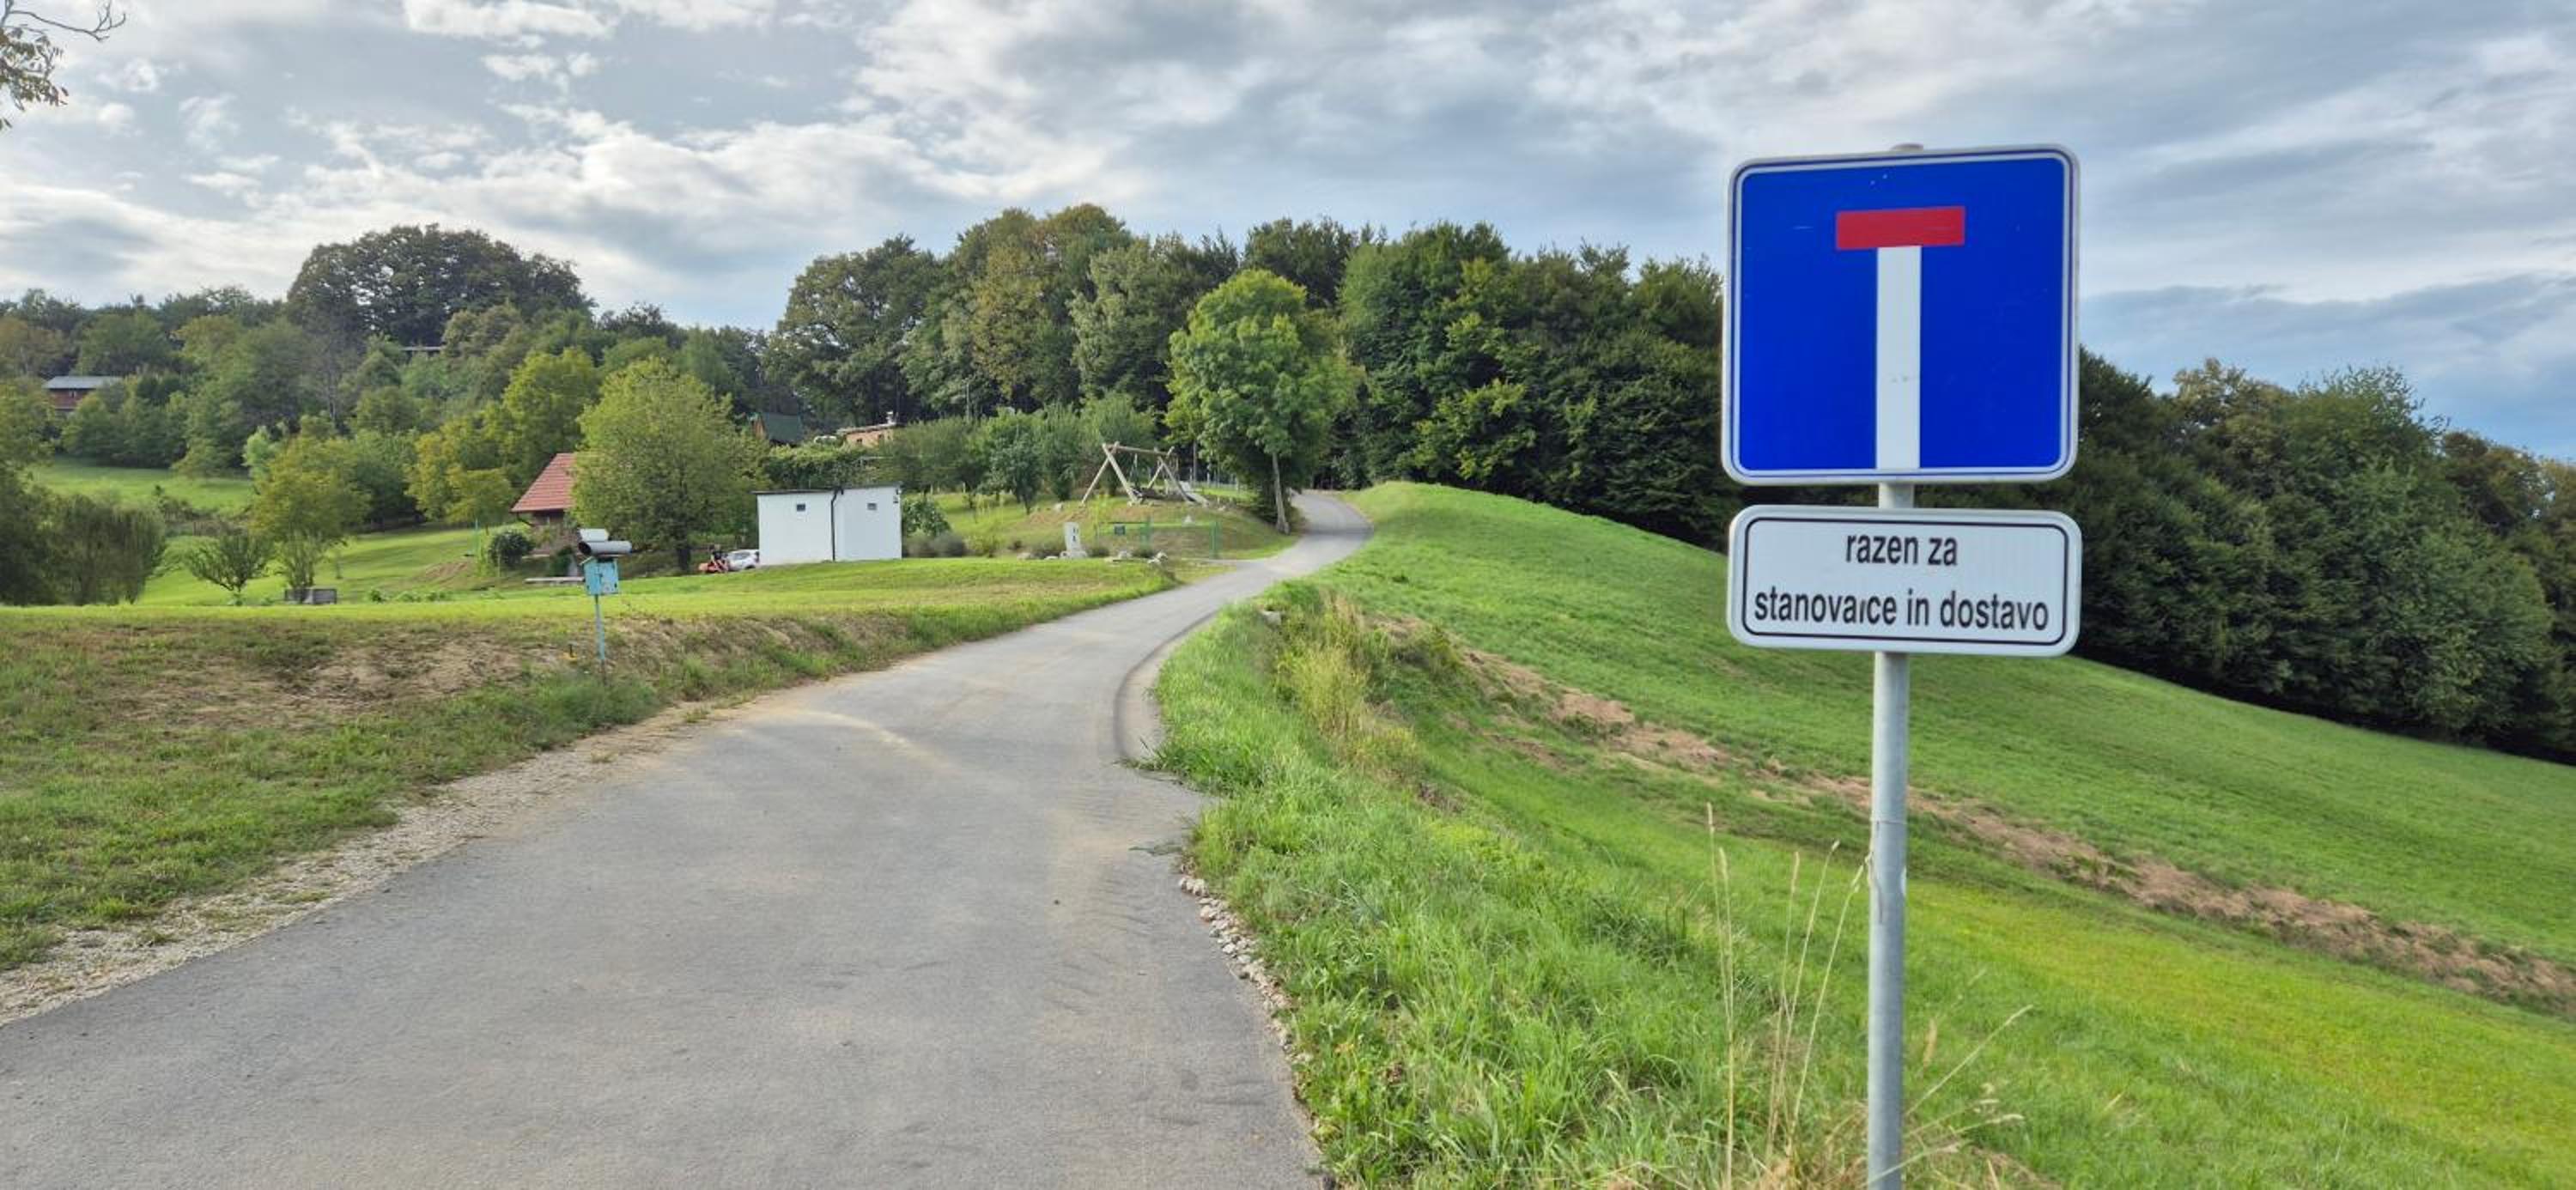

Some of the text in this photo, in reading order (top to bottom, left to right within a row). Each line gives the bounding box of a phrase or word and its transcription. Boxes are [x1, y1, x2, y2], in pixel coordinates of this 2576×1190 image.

[1844, 534, 1959, 567] razen za
[1906, 588, 1930, 627] in
[1939, 590, 2050, 632] dostavo
